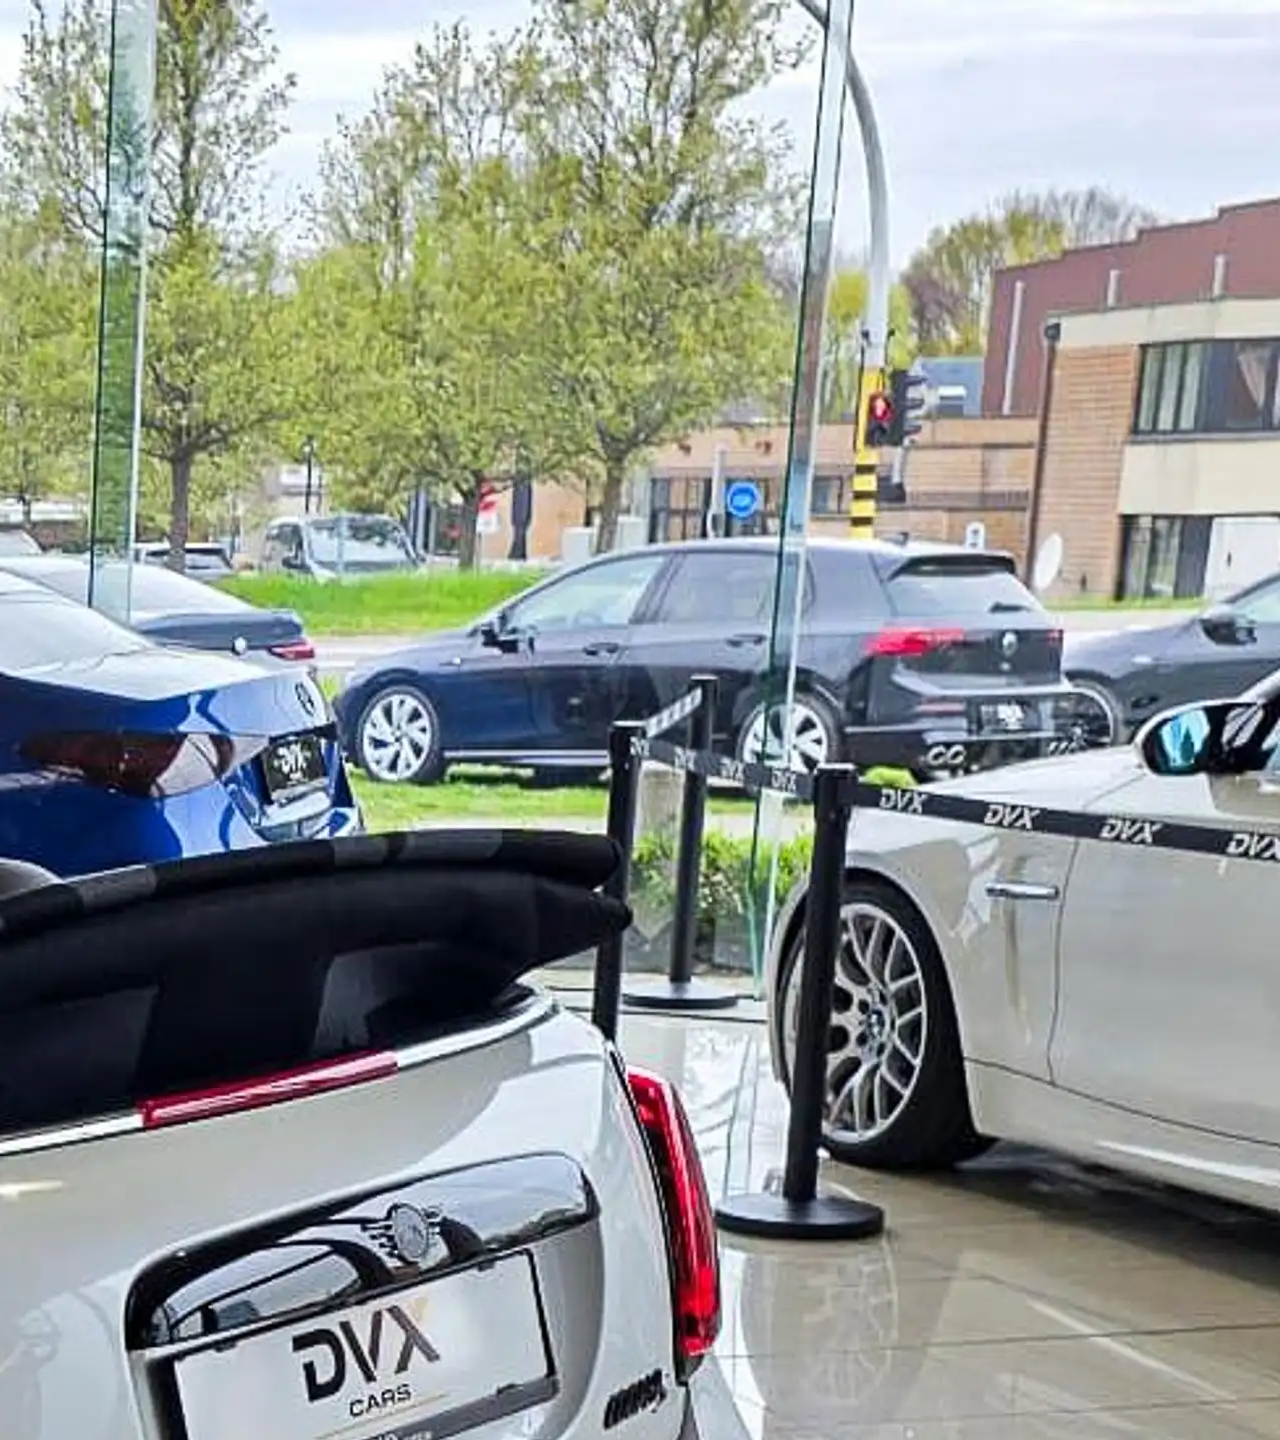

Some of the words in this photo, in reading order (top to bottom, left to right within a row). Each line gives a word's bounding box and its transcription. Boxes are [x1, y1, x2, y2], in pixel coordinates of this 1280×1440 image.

[879, 787, 928, 814] DVX
[984, 804, 1041, 830] DVX
[1099, 817, 1163, 844] DVX
[292, 1304, 440, 1403] DVX
[349, 1384, 412, 1418] CARS
